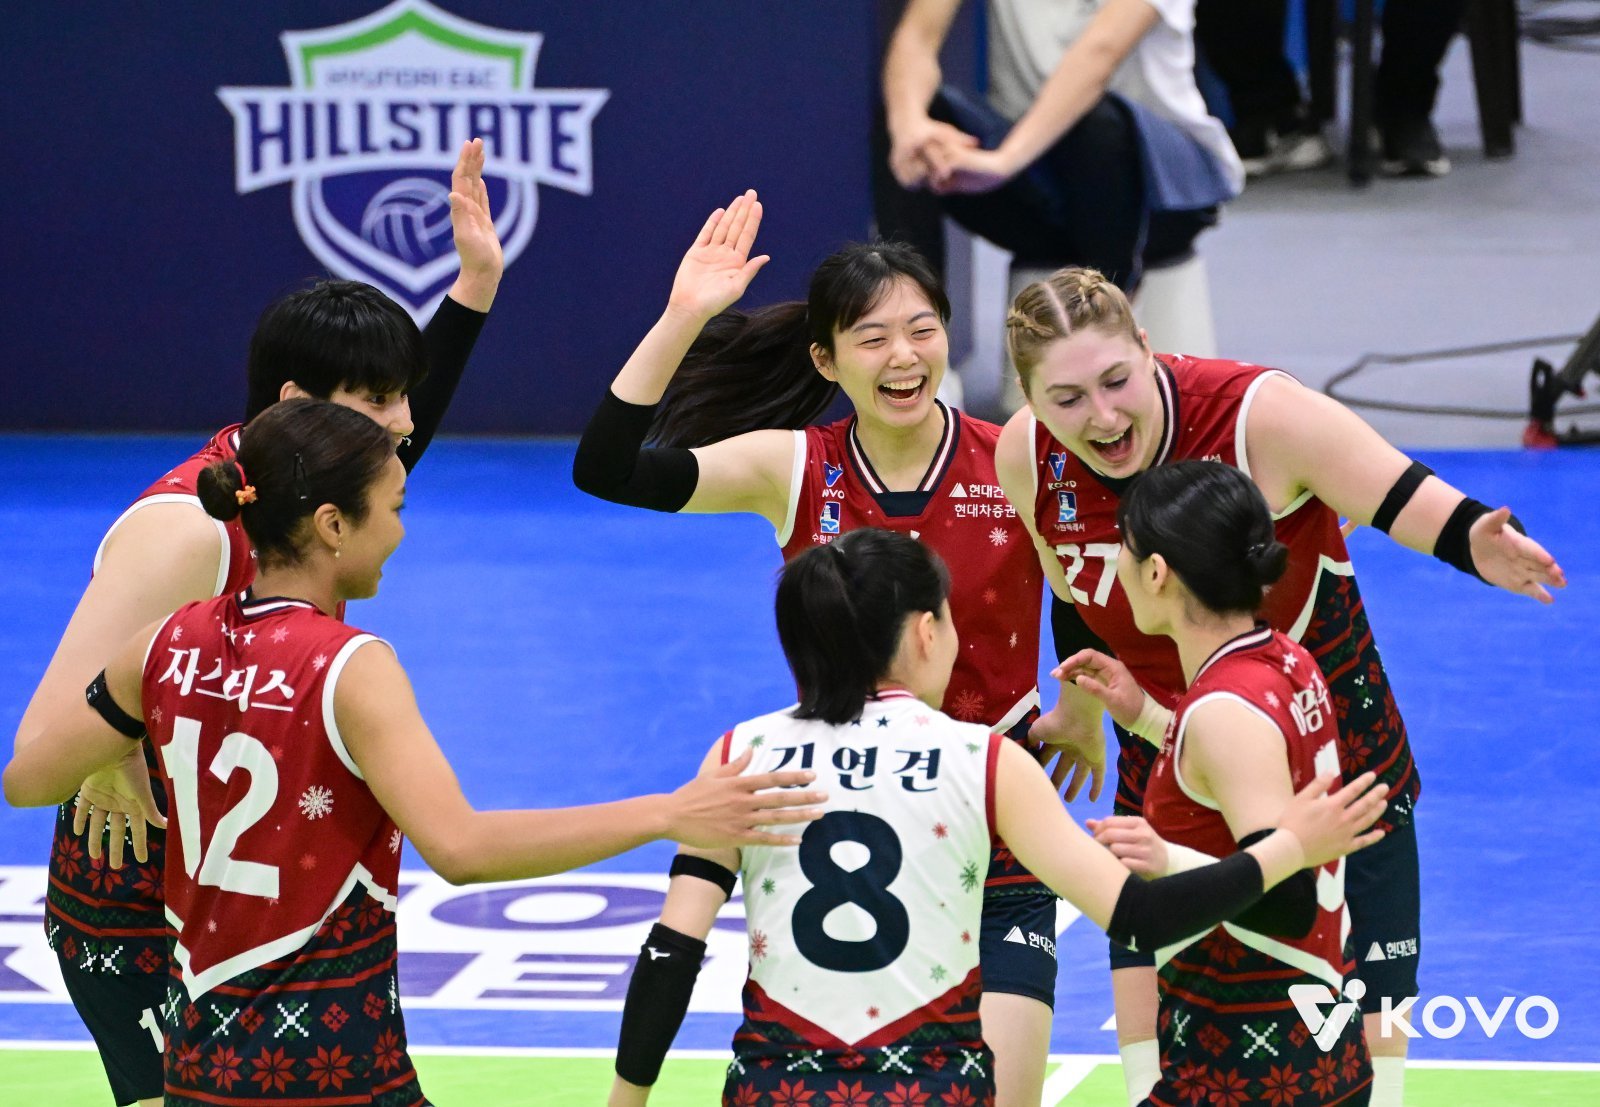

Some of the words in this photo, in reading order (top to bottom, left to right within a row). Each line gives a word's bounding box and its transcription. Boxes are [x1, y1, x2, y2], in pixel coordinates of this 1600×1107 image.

[245, 102, 582, 175] HILLSTATE
[954, 504, 1016, 518] 현대차증권
[969, 484, 1005, 498] 현대건
[1056, 543, 1122, 608] 27
[160, 716, 280, 899] 12
[791, 810, 910, 974] 8
